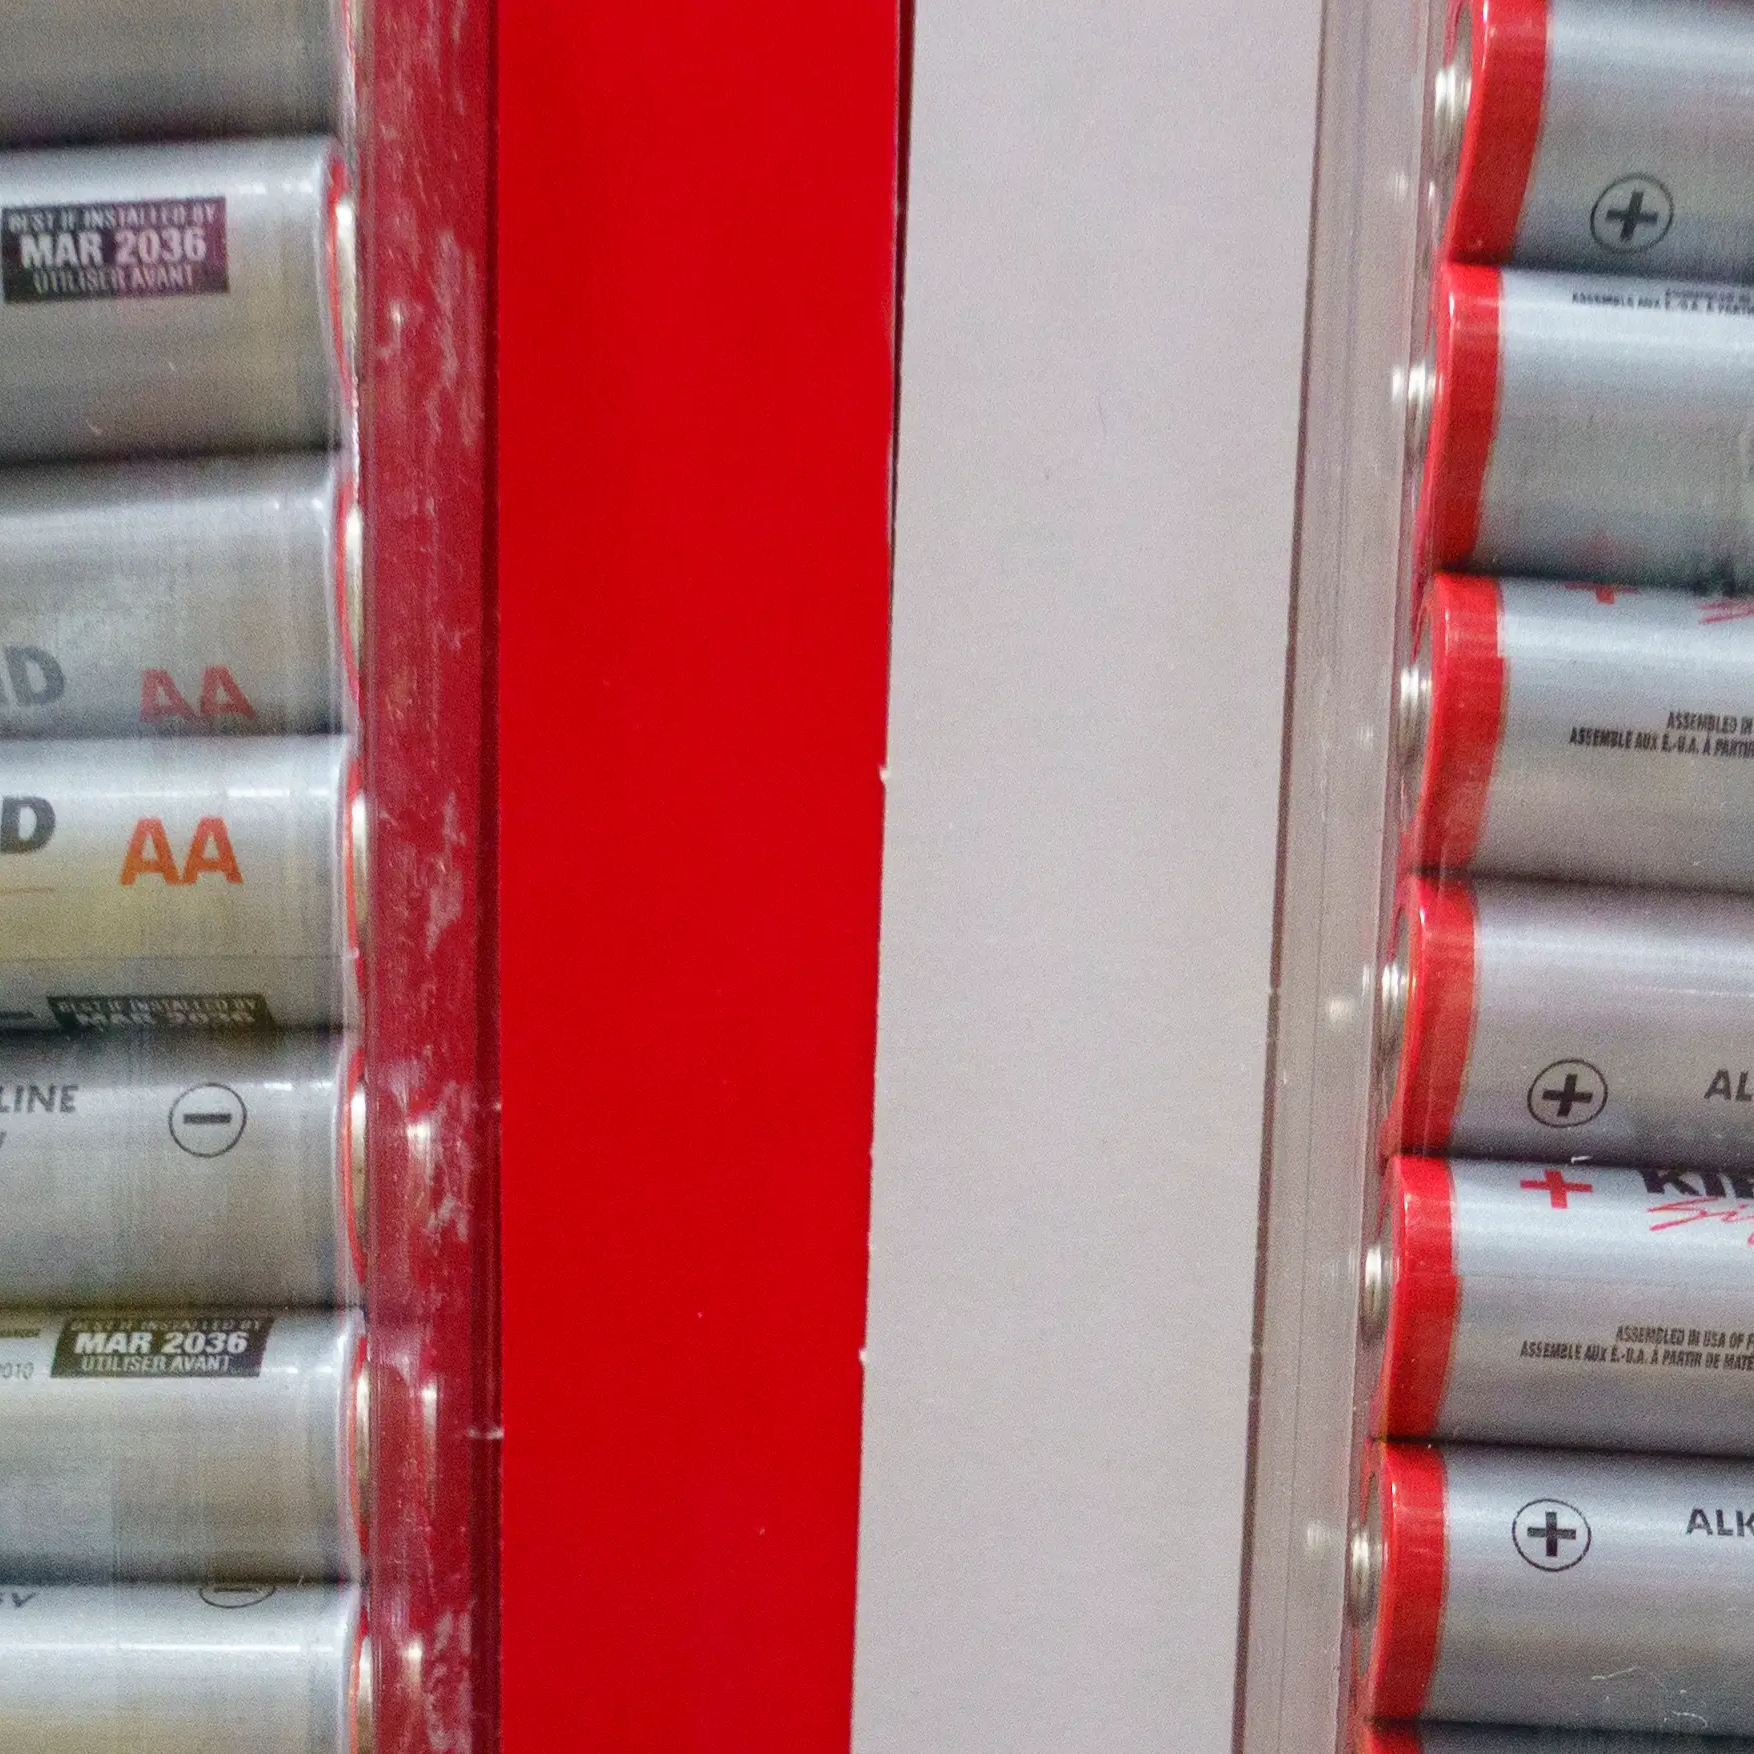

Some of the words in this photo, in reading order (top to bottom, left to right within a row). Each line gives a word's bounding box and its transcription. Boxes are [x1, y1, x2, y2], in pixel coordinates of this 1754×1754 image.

[20, 231, 103, 267] MAR
[114, 228, 207, 265] 2036
[33, 266, 125, 295] UTILISER
[130, 264, 194, 291] AVANT
[140, 664, 257, 723] AA
[120, 816, 243, 886] AA
[74, 1332, 153, 1354] MAR
[160, 1331, 250, 1354] 2036
[1583, 1344, 1607, 1363] AUX
[1702, 1330, 1726, 1349] USA
[1728, 1331, 1744, 1350] OF
[82, 1355, 165, 1372] UTILISER
[170, 1355, 233, 1371] AVANT
